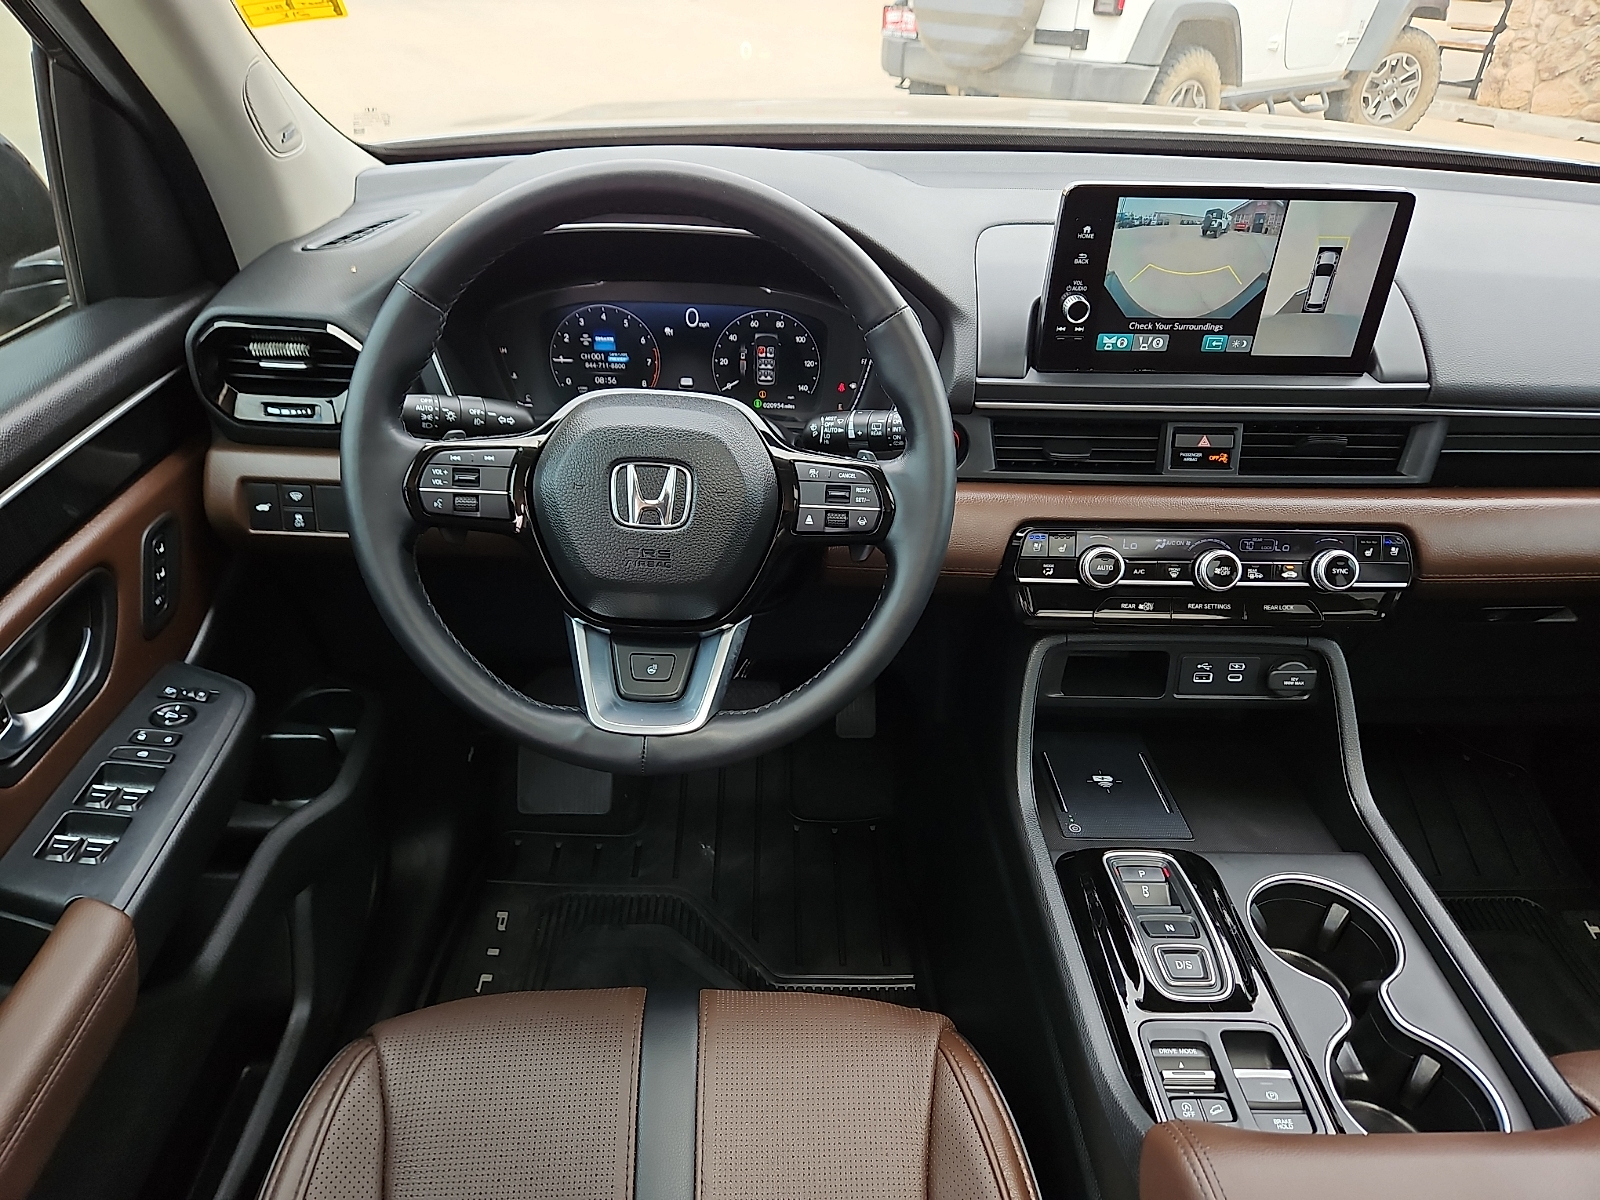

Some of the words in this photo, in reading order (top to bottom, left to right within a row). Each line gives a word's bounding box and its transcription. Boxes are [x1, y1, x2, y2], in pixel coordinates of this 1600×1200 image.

[600, 312, 607, 321] 4
[685, 307, 699, 328] 0
[579, 317, 585, 326] 3
[623, 319, 629, 328] 5
[750, 320, 759, 328] 60
[1129, 322, 1153, 330] Check
[1173, 323, 1223, 332] Surroundings
[563, 333, 570, 343] 2
[640, 336, 646, 344] 6
[646, 358, 652, 367] 7
[565, 377, 572, 386] 0
[641, 380, 647, 388] 8
[1331, 567, 1349, 575] SYNC
[1138, 870, 1146, 878] P
[1164, 923, 1175, 932] N
[1175, 960, 1193, 970] D/S
